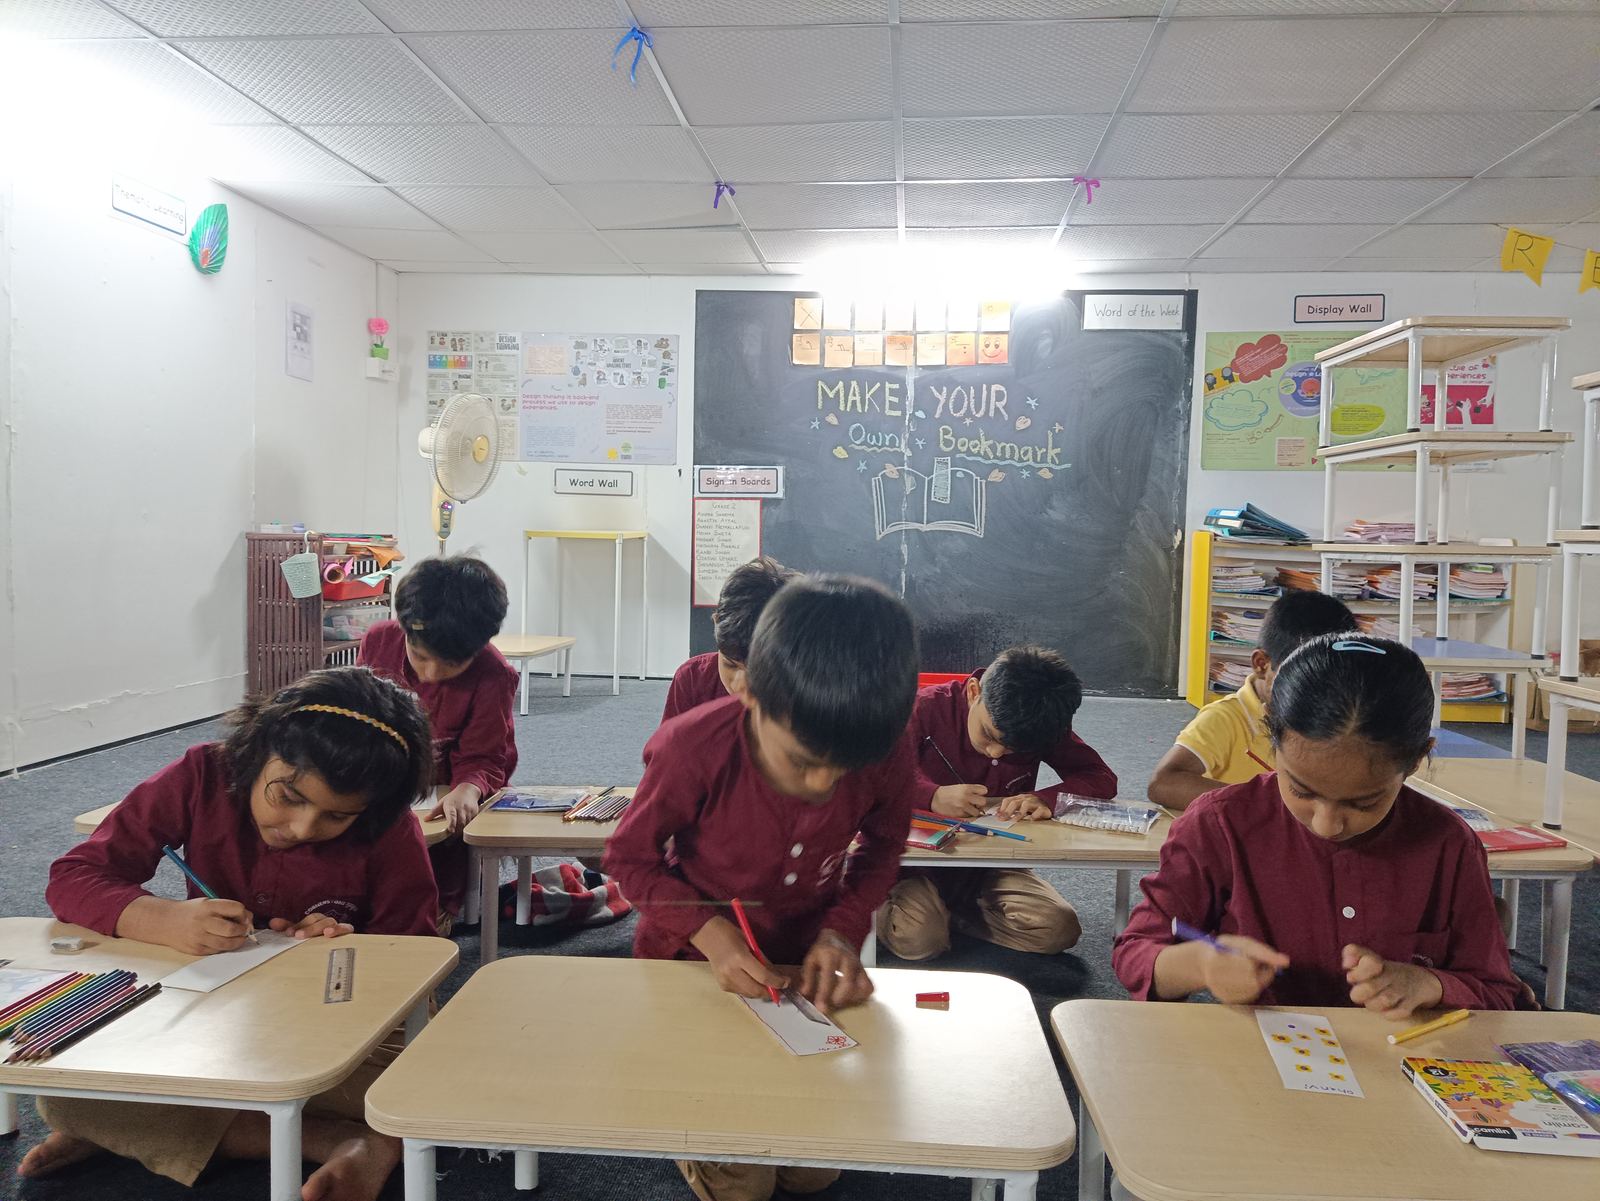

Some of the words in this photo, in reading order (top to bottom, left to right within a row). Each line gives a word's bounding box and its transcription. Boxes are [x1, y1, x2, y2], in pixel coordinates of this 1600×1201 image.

[1511, 233, 1535, 268] R
[1093, 303, 1122, 317] Word
[1127, 303, 1140, 317] of
[1140, 304, 1156, 317] the
[1159, 303, 1180, 316] Week
[1307, 304, 1345, 316] Display
[1348, 303, 1372, 314] Wall
[817, 379, 902, 417] MAKE
[929, 383, 1009, 421] YOUR
[848, 423, 900, 447] Own
[938, 425, 1061, 464] Bookmark
[568, 478, 594, 487] Word
[597, 479, 618, 488] Wall
[705, 477, 725, 488] Sign
[740, 476, 771, 486] Boards
